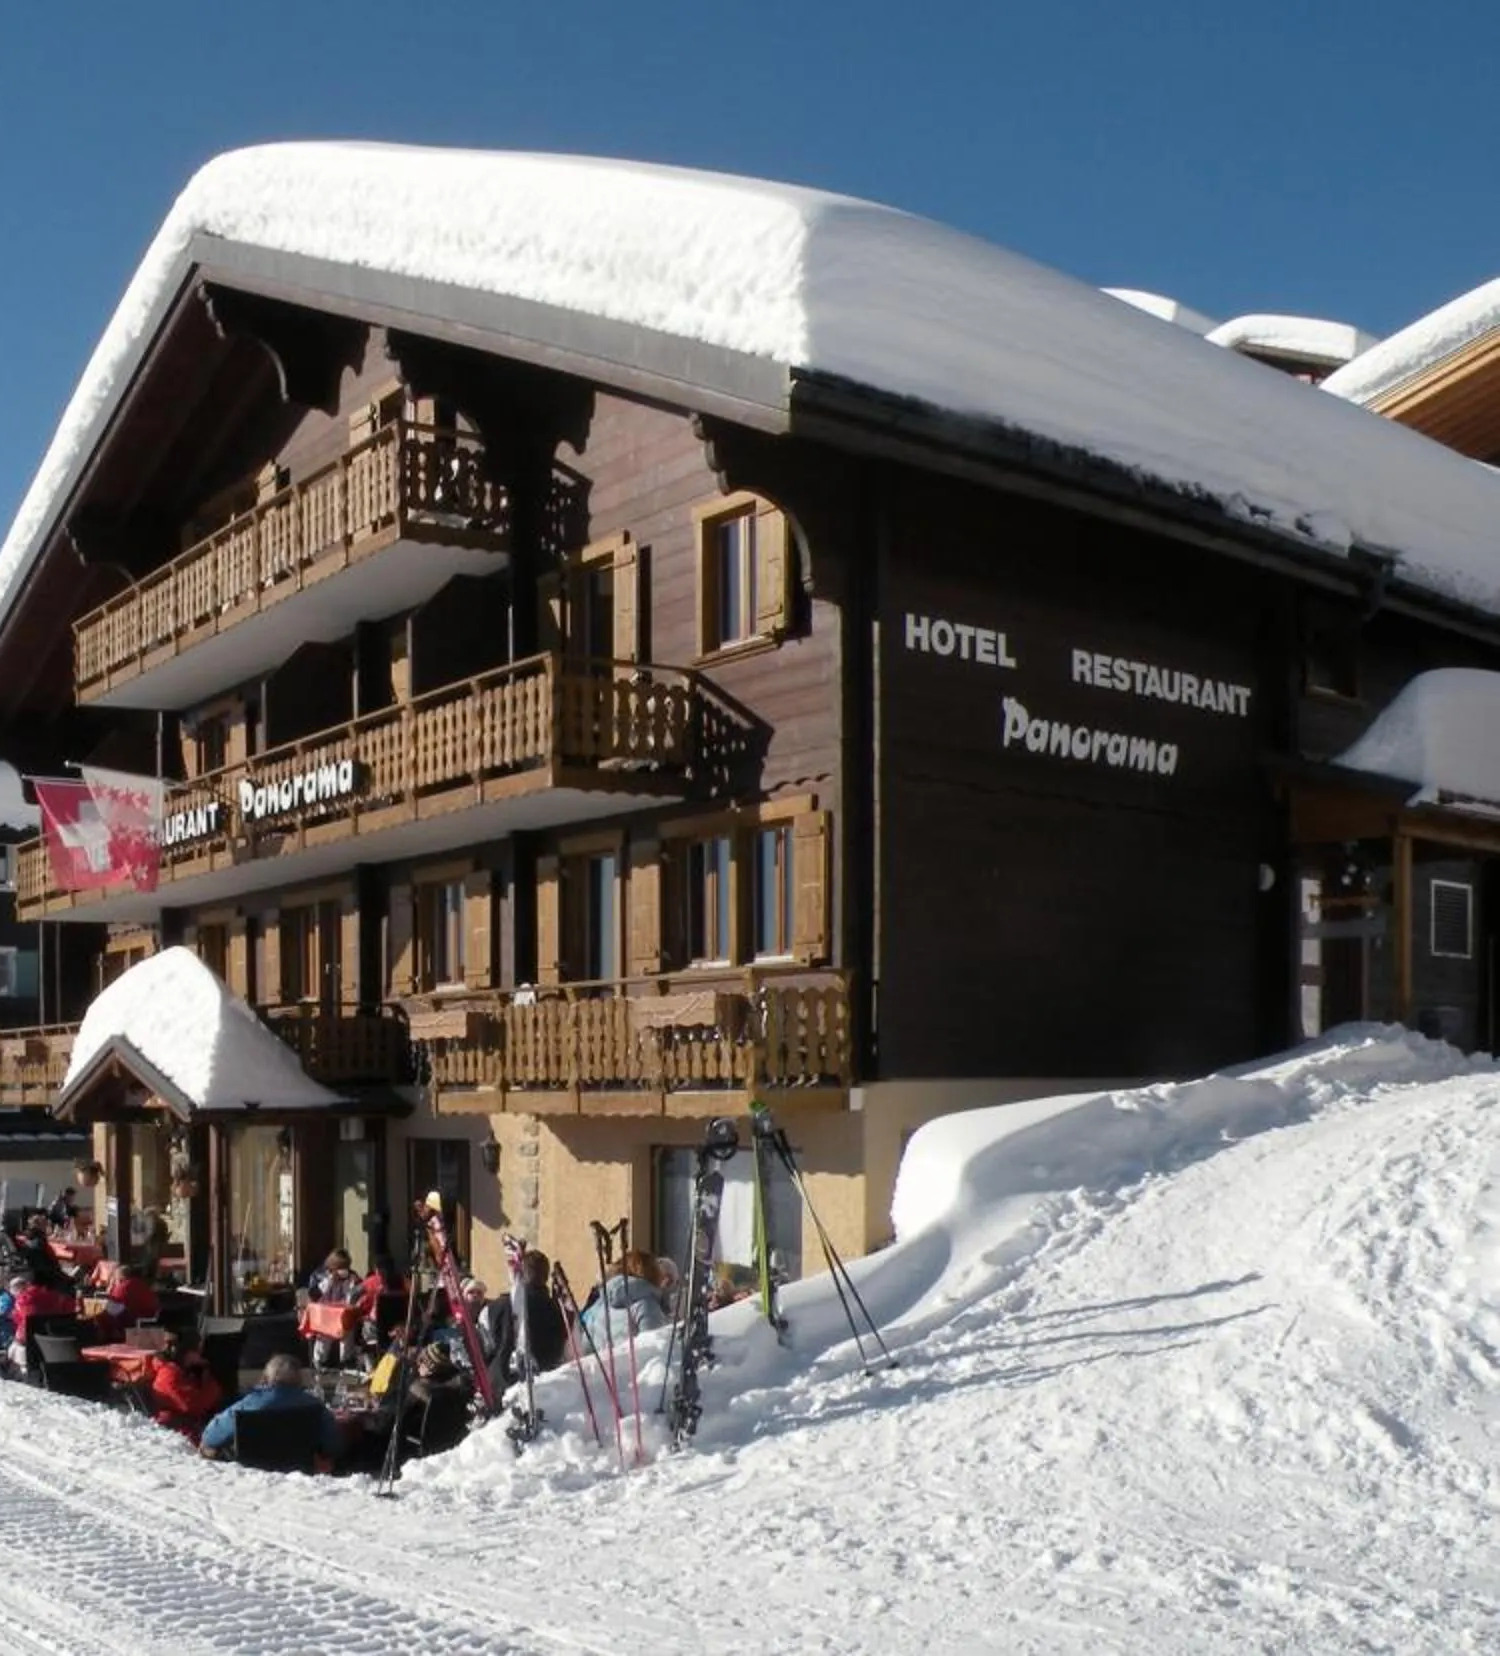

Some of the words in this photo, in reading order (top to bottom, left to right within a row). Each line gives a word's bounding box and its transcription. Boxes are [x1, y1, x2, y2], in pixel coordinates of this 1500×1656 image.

[905, 613, 1016, 668] HOTEL
[1072, 649, 1251, 716] RESTAURANT
[1003, 697, 1178, 775] Panorama
[161, 801, 219, 846] URANT
[239, 760, 352, 820] Panorama
